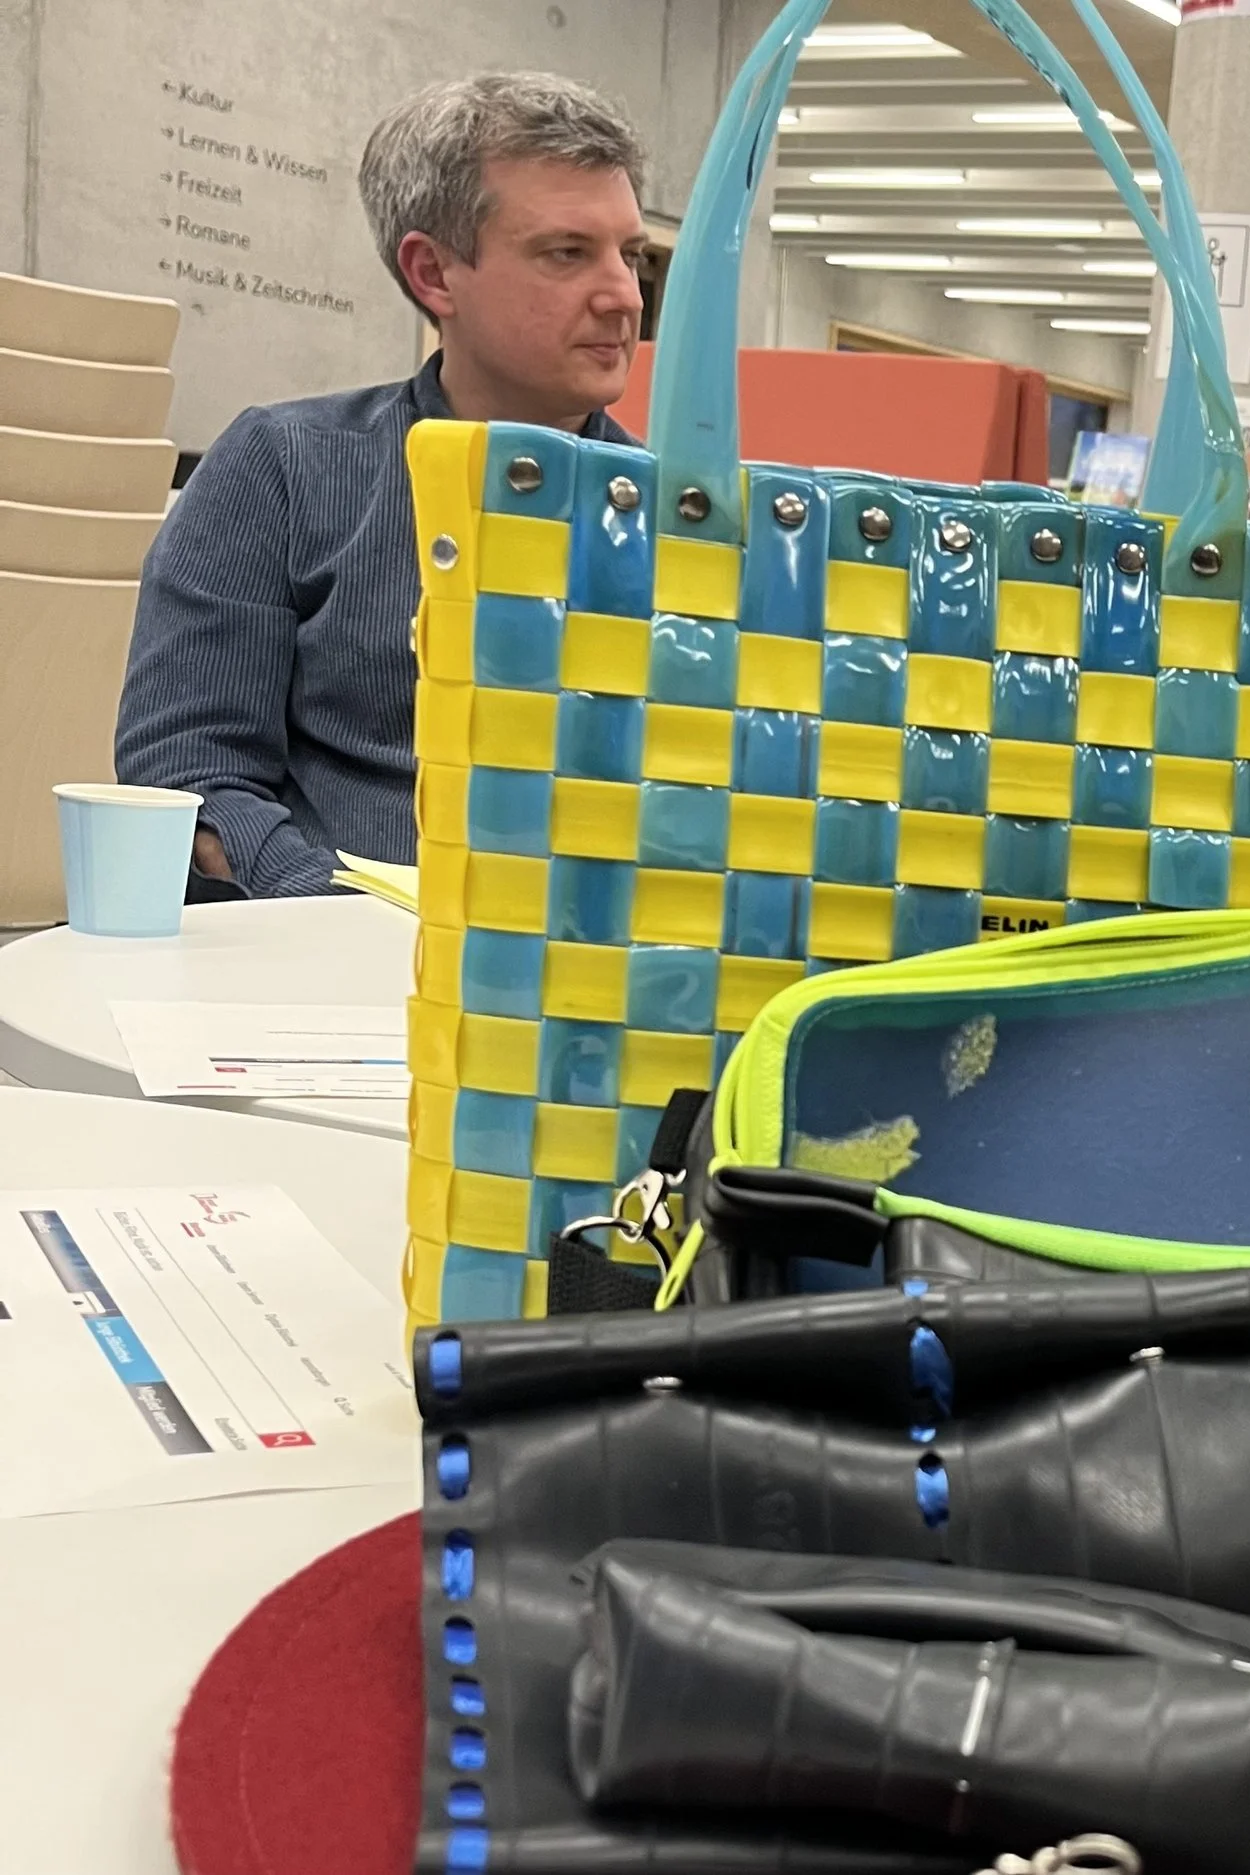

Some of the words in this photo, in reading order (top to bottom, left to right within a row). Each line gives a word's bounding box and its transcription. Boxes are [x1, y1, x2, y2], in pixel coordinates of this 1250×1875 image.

[178, 82, 234, 113] Kultur
[177, 126, 241, 161] Lernen
[245, 144, 259, 165] &
[262, 148, 328, 184] Wissen
[176, 170, 242, 205] Freizeit
[175, 214, 250, 250] Romane
[175, 260, 229, 288] Musik
[233, 271, 248, 293] &
[251, 274, 354, 315] Zeitschriften
